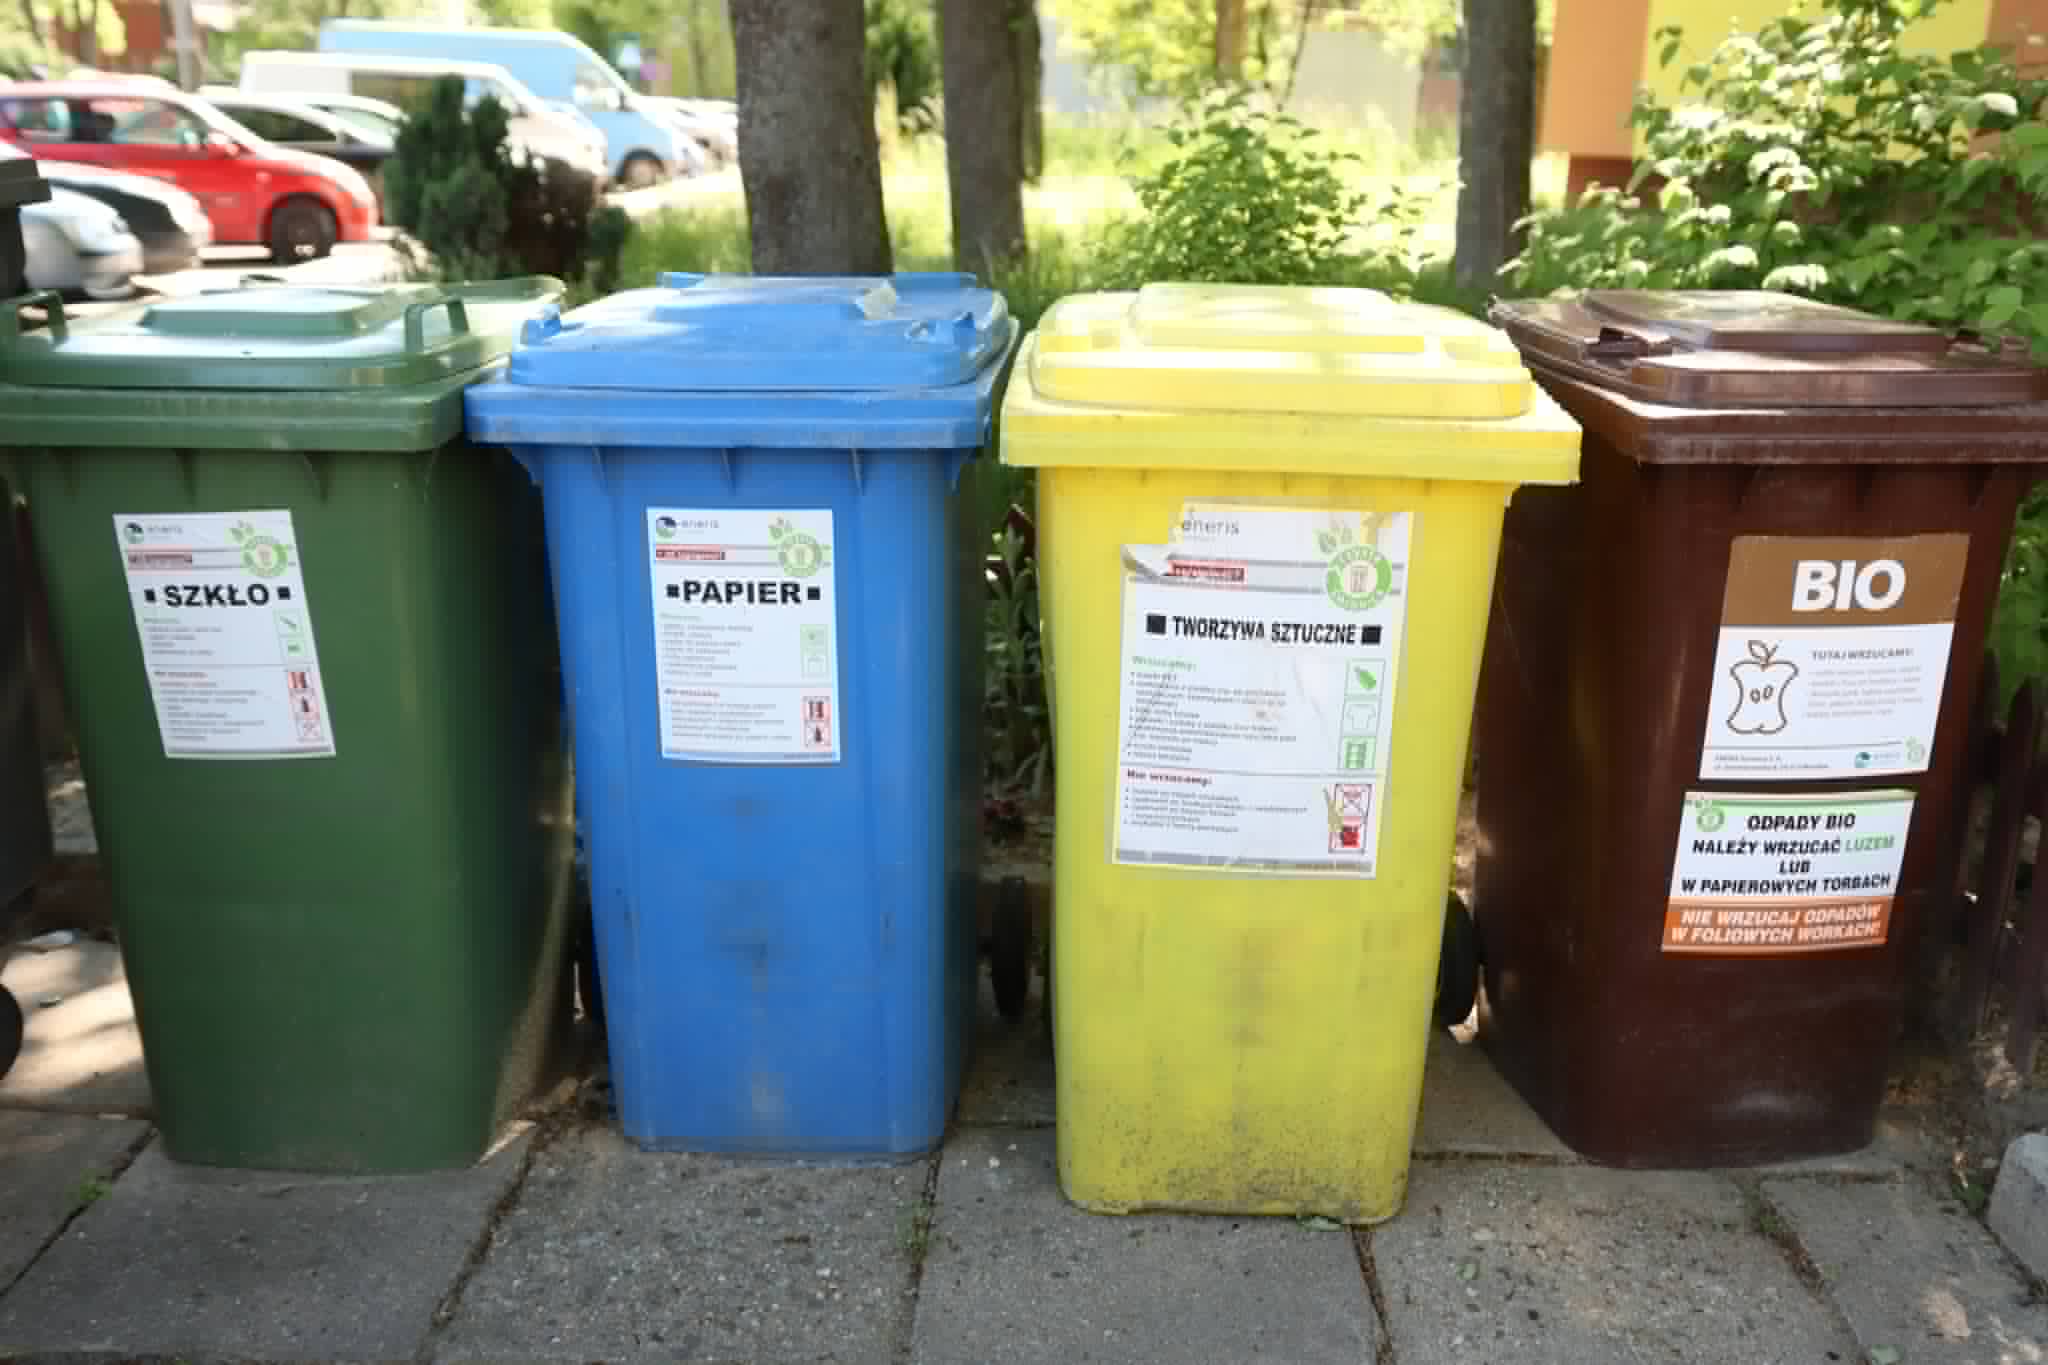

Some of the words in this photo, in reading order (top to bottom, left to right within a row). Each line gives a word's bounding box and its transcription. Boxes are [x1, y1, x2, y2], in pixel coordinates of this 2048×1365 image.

[164, 583, 270, 608] SZKŁO
[683, 580, 802, 605] PAPIER
[1792, 559, 1907, 612] BIO
[1172, 615, 1264, 641] TWORZYWA
[1271, 622, 1357, 645] SZTUCZNE
[1747, 815, 1822, 832] ODPADY
[1826, 812, 1856, 830] BIO
[1692, 836, 1760, 856] NALEŻY
[1763, 837, 1841, 856] WRZUCAĆ
[1845, 836, 1895, 852] LUZEM
[1779, 860, 1811, 875] LUB
[1681, 880, 1697, 893] W
[1701, 878, 1817, 895] PAPIEROWYCH
[1823, 873, 1891, 892] TORBACH
[1682, 911, 1713, 925] NIE
[1717, 909, 1801, 926] WRZUCAJ
[1804, 904, 1882, 923] ODPADÓW
[1670, 927, 1687, 943] W
[1691, 926, 1793, 944] FOLIOWYCH
